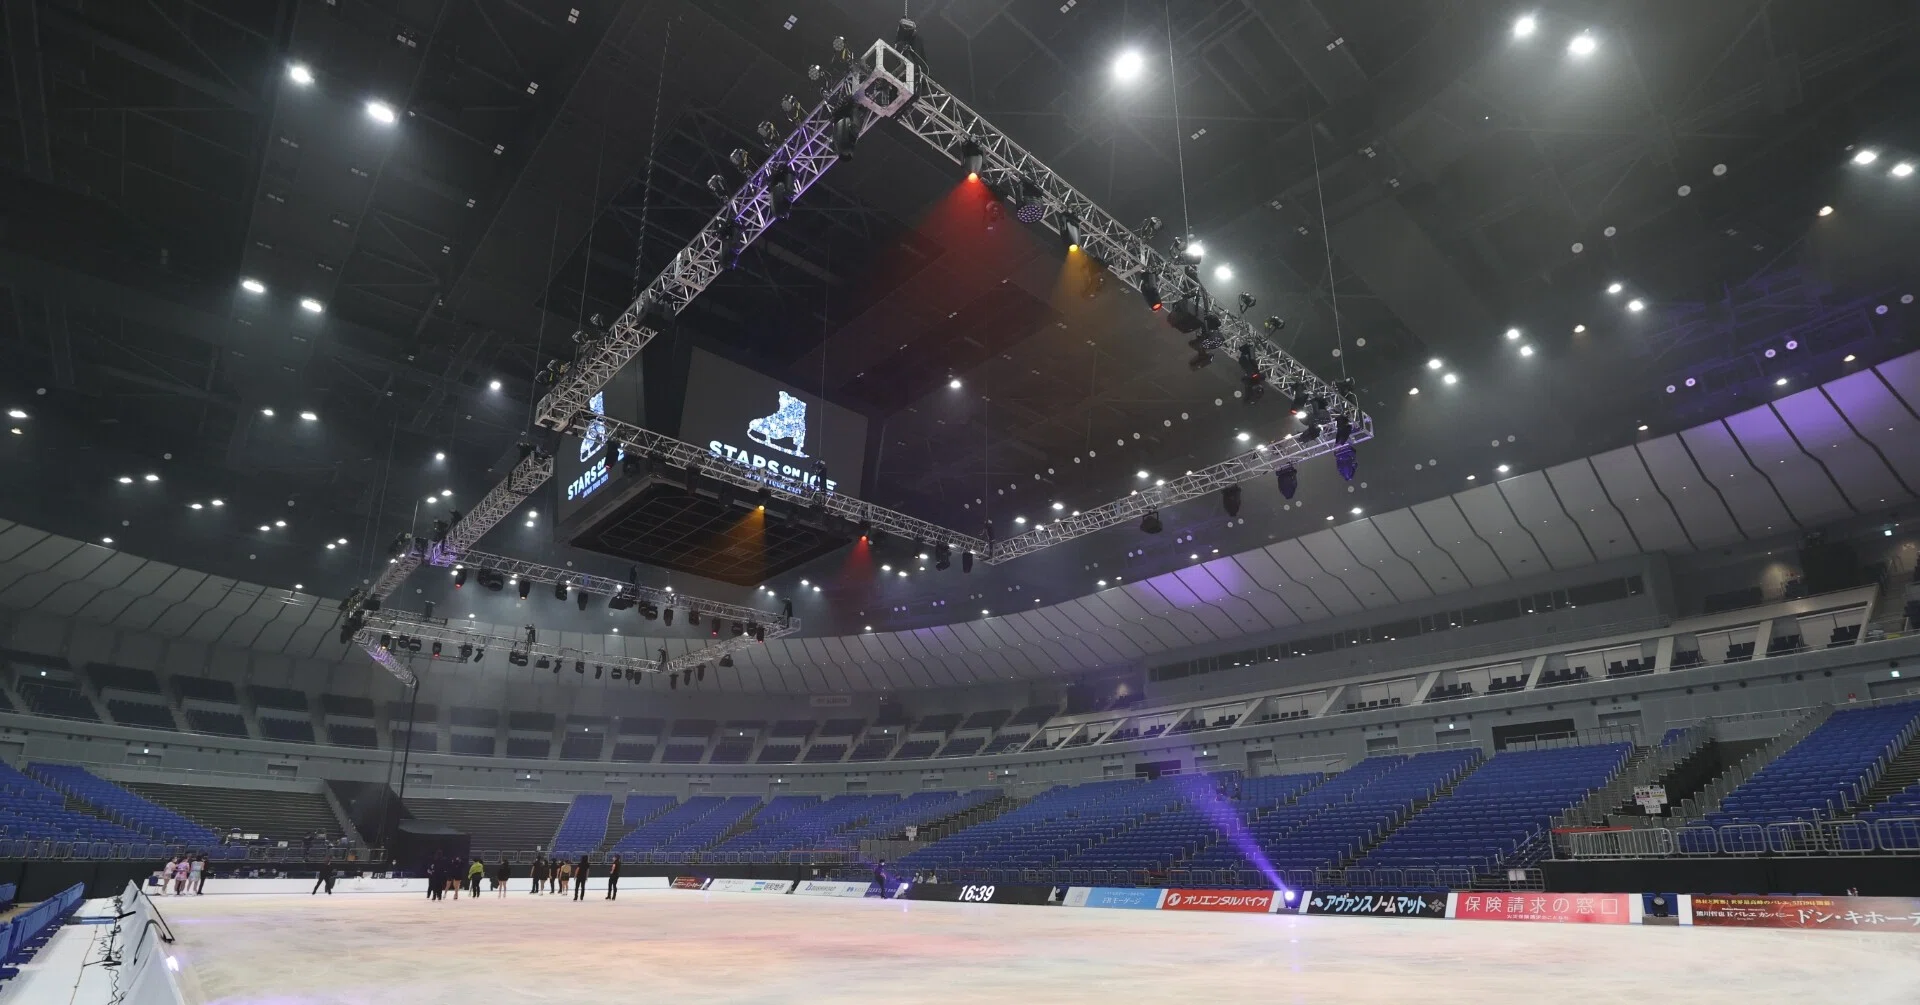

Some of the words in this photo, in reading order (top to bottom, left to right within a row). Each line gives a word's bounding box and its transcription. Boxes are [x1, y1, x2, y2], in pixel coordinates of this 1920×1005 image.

[708, 440, 780, 474] STARS
[782, 465, 800, 478] ON
[568, 465, 597, 501] STARS
[959, 885, 995, 902] 16:39
[1183, 895, 1270, 907] オリエンタルバイオ
[1464, 896, 1619, 916] 保険請求の窓口
